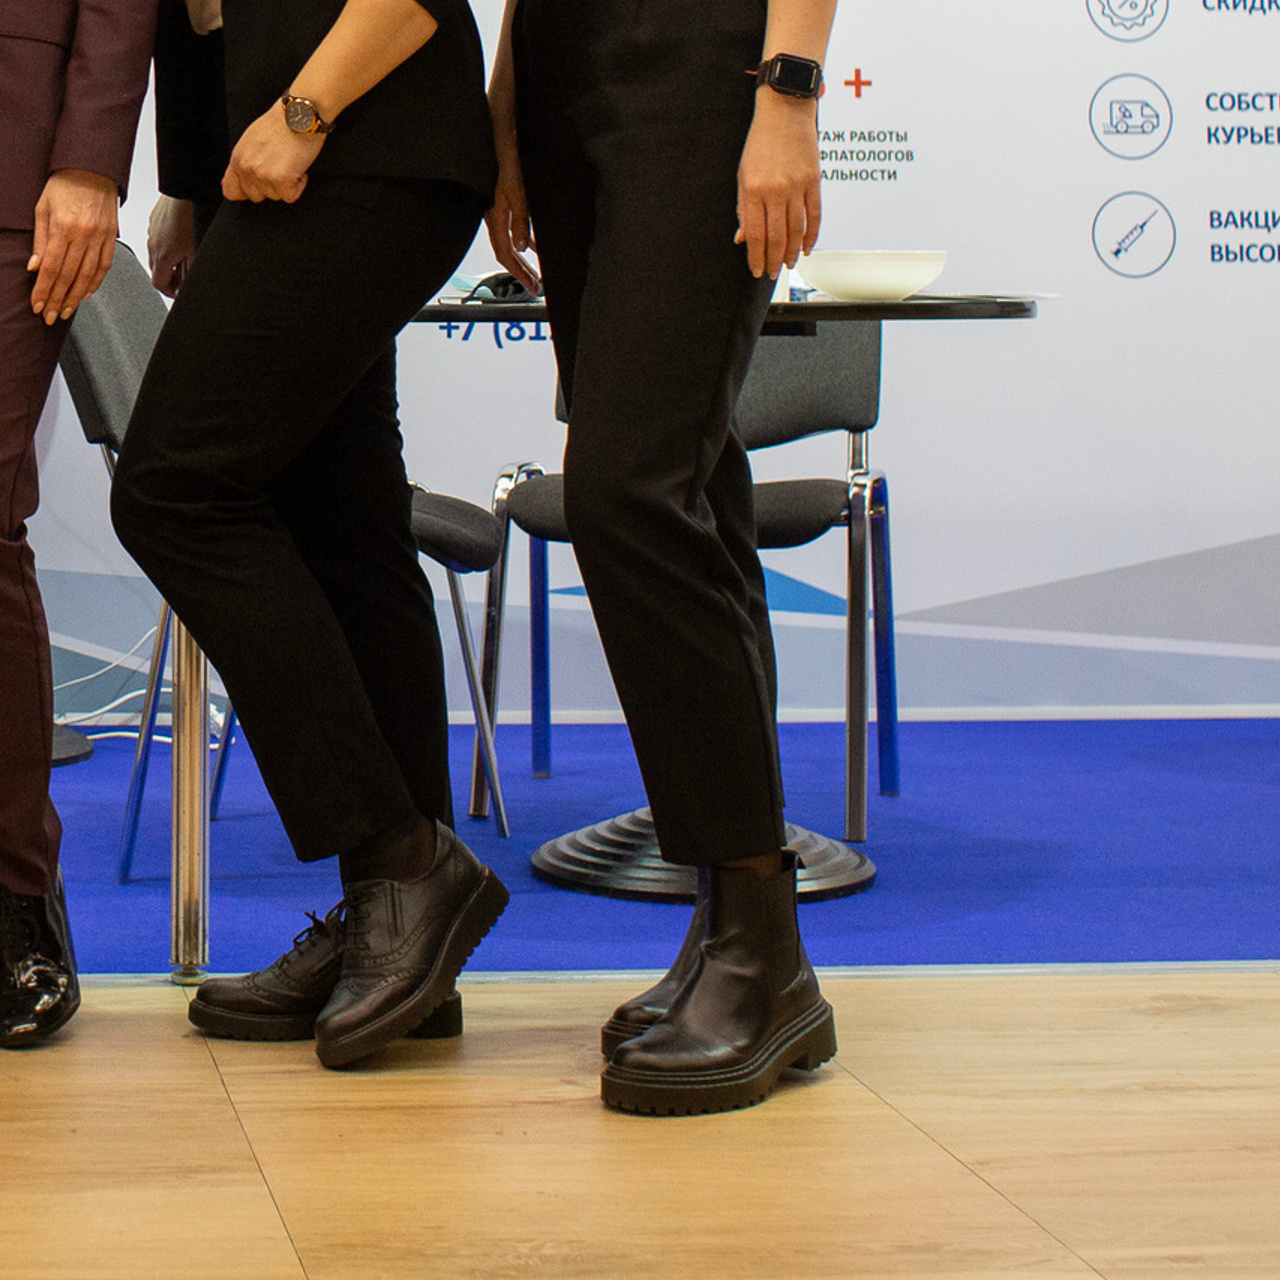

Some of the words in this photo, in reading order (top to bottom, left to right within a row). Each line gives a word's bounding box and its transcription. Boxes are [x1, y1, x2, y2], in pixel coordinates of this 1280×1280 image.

[850, 131, 908, 143] РАБОТЫ
[1206, 126, 1280, 145] КУРЬЕ
[1210, 244, 1280, 263] ВЫСО
